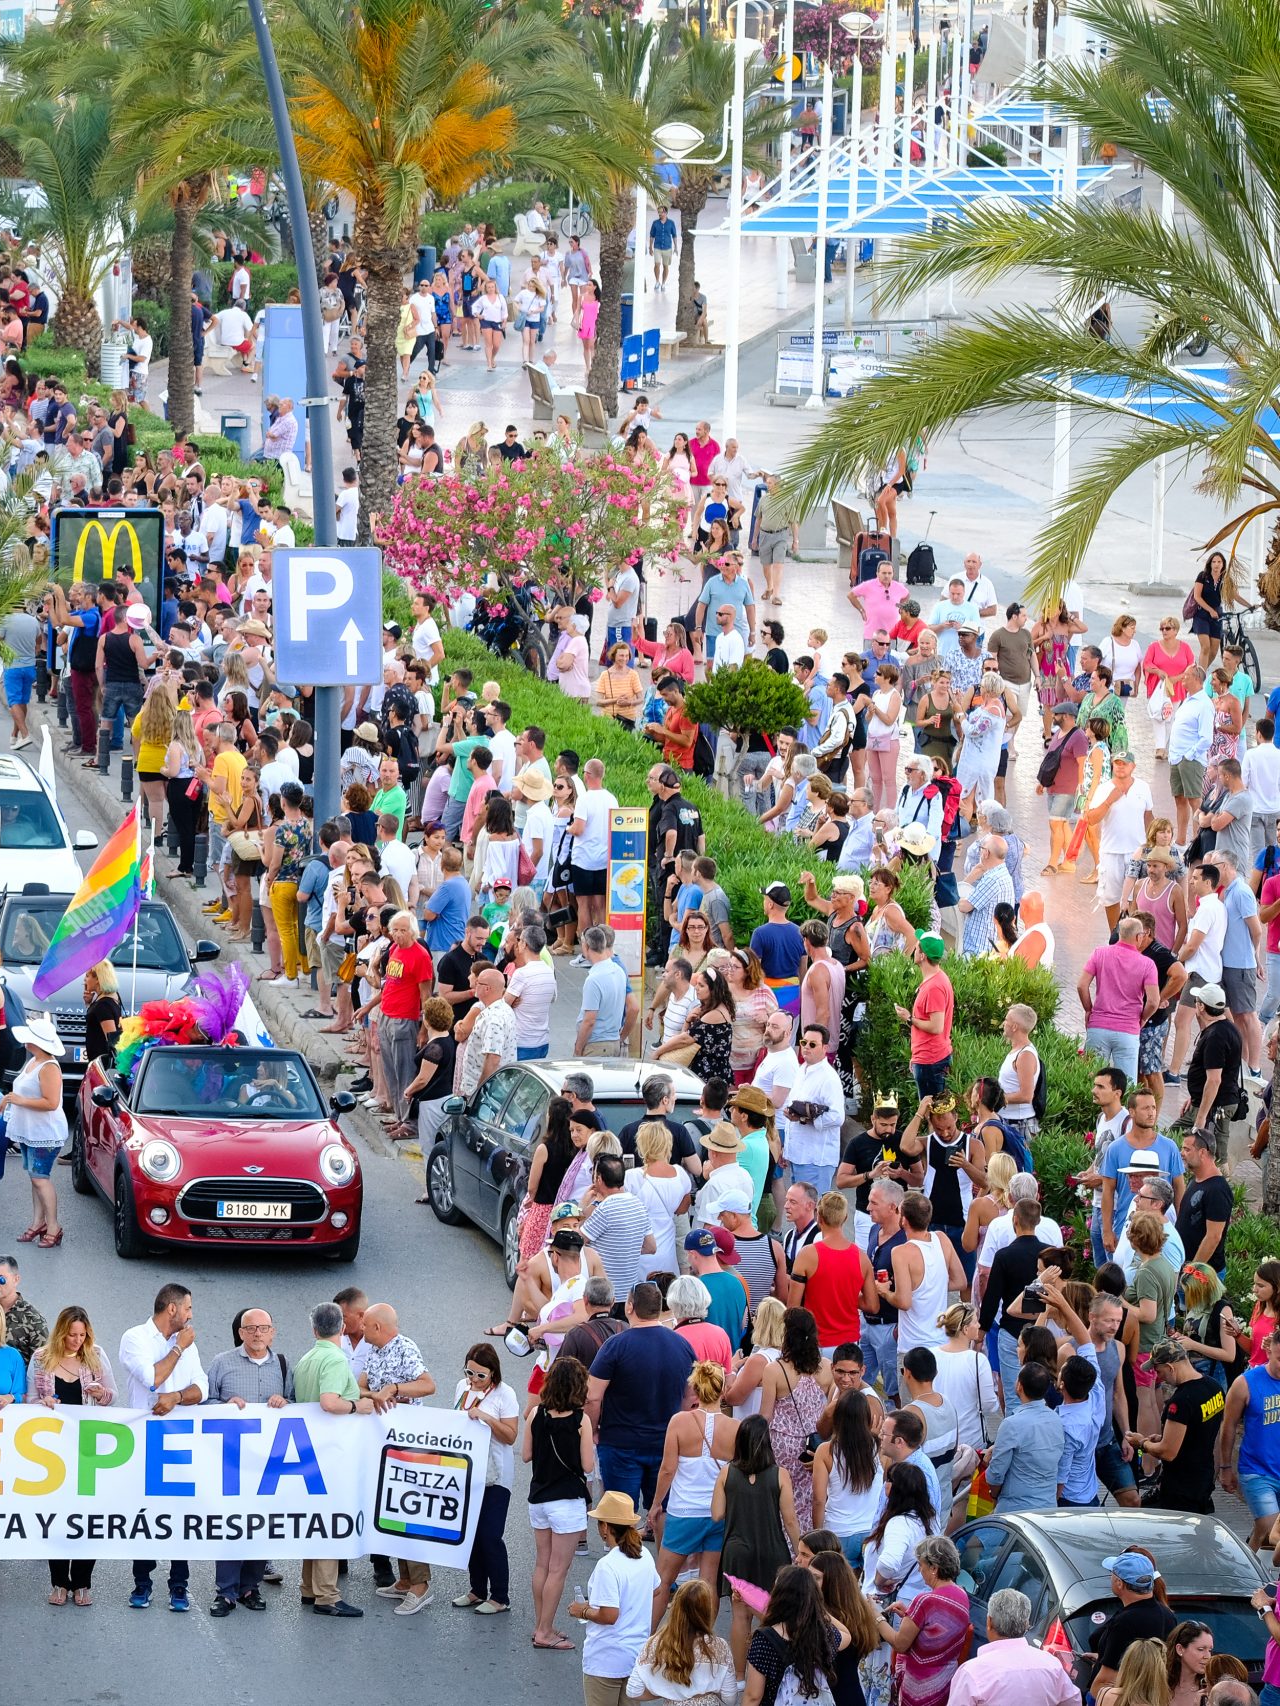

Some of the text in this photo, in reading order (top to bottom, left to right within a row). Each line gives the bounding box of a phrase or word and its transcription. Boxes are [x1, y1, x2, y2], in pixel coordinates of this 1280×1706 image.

[289, 557, 353, 642] P
[226, 1203, 288, 1217] 8180 JYK
[386, 1427, 474, 1451] Asociación
[389, 1465, 460, 1492] IBIZA
[384, 1487, 460, 1522] LGTB
[35, 1513, 57, 1540] Y
[66, 1508, 173, 1541] SERÁS
[183, 1510, 365, 1541] RESPETADO
